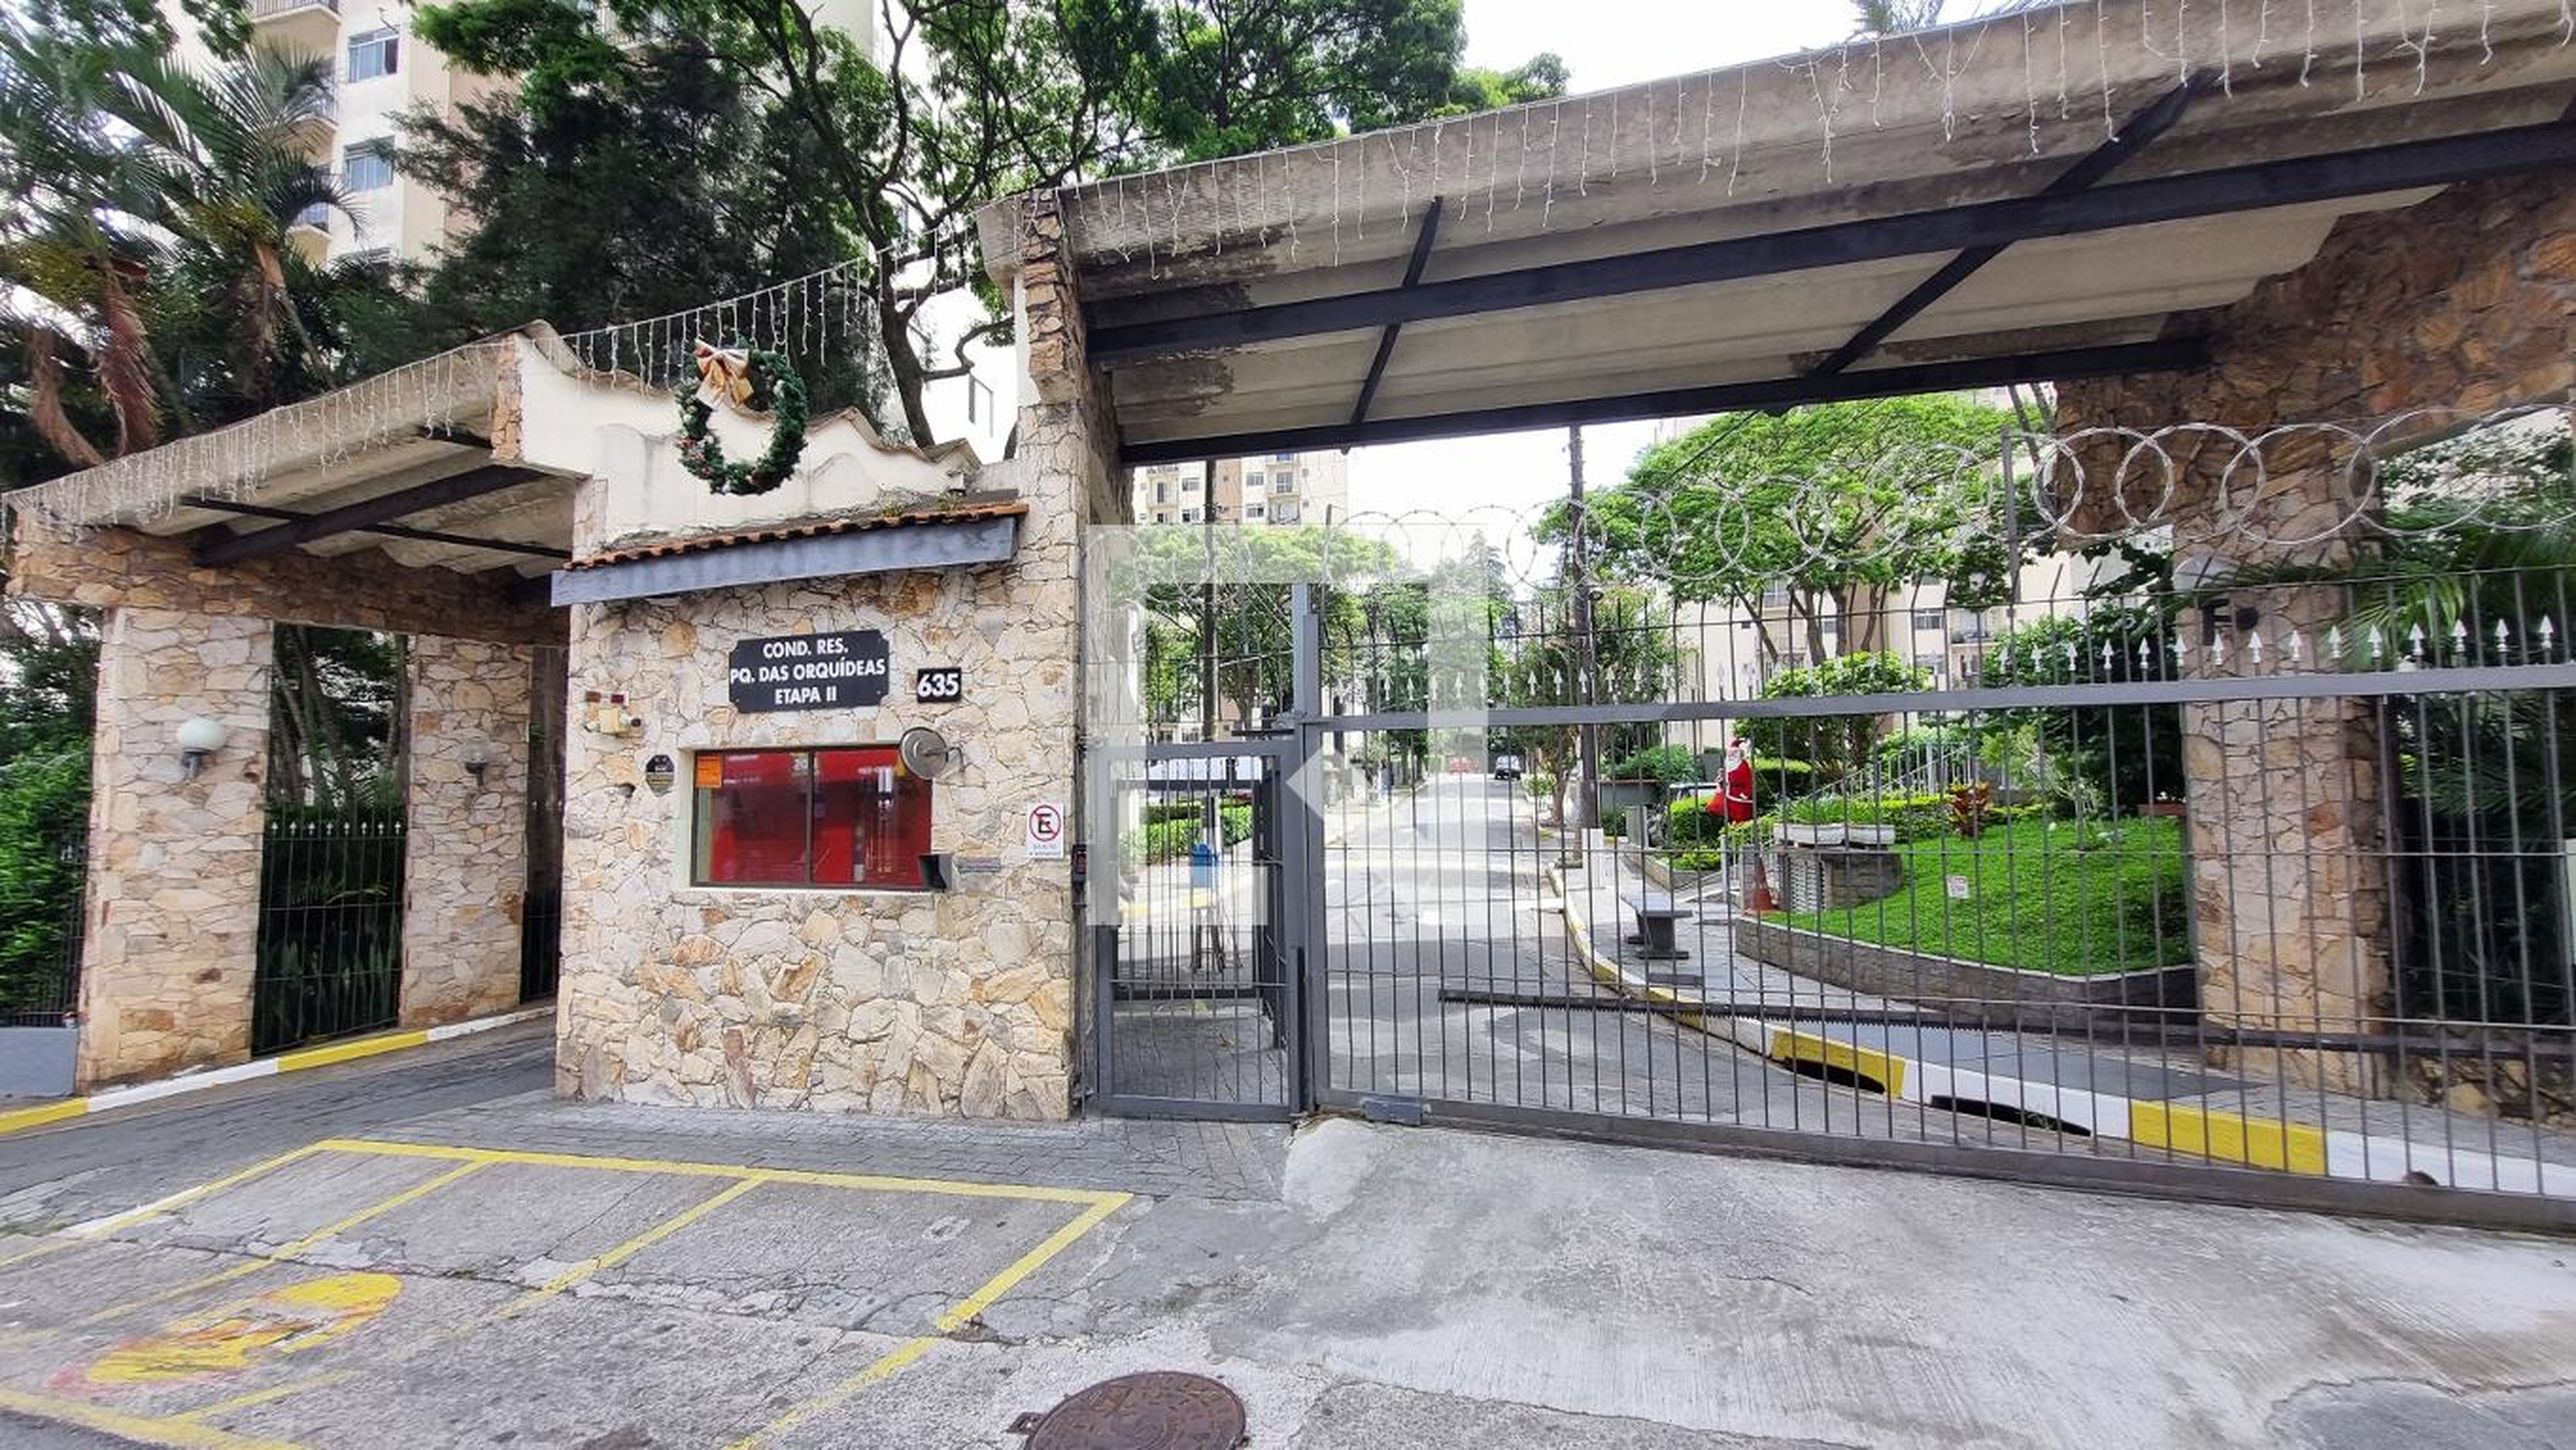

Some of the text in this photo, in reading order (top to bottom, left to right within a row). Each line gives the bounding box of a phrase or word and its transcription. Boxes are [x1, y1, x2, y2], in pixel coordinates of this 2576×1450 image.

[763, 638, 849, 659] COND. RES.
[730, 657, 885, 685] PQ. DAS ORQUÍDEAS
[775, 685, 837, 705] ETAPA II
[917, 673, 959, 697] 635
